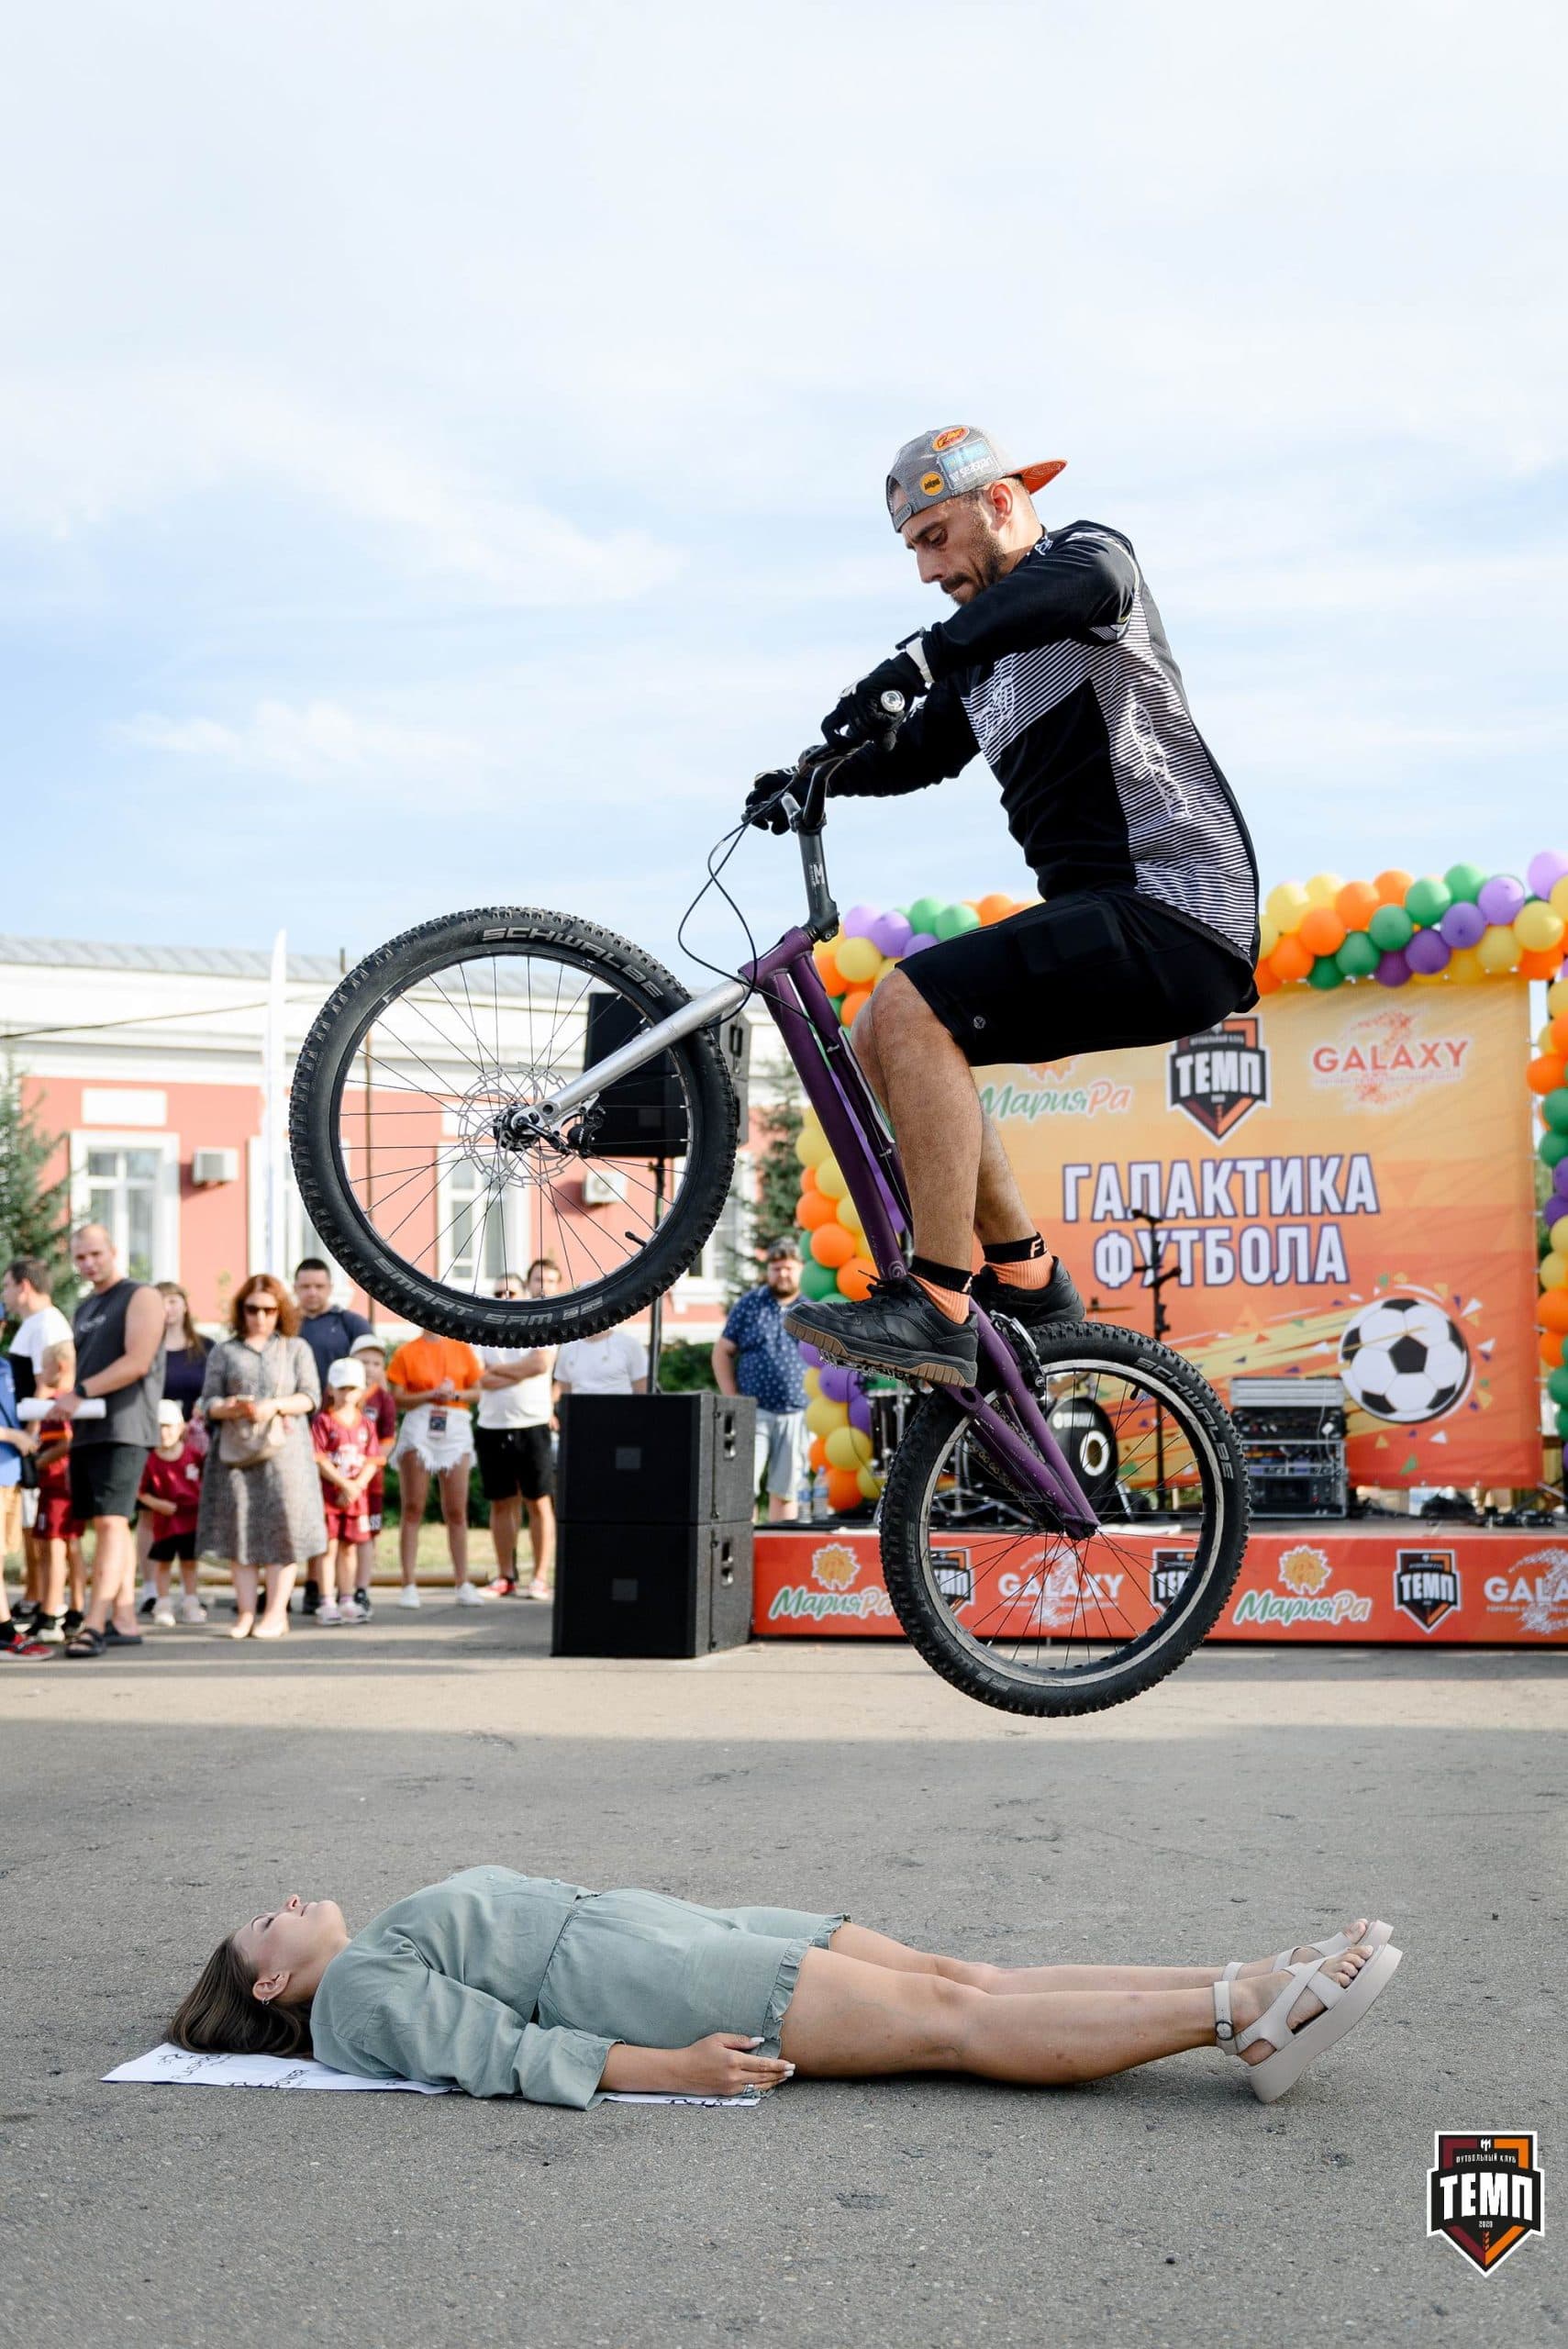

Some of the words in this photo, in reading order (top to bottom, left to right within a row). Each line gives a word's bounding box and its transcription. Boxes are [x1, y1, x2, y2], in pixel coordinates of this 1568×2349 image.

[482, 927, 664, 998] SCHWALBE
[1174, 1050, 1262, 1098] ТЕМП
[1312, 1041, 1468, 1074] GALAXY
[1062, 1153, 1380, 1223] ГАЛАКТИКА
[1094, 1223, 1351, 1290] ФУТБОЛА
[373, 1256, 474, 1317] SMART
[482, 1312, 553, 1327] SAM
[1134, 1357, 1235, 1480] SCHWALBE
[998, 1573, 1125, 1599] GALAXY
[1399, 1571, 1455, 1603] ТЕМП
